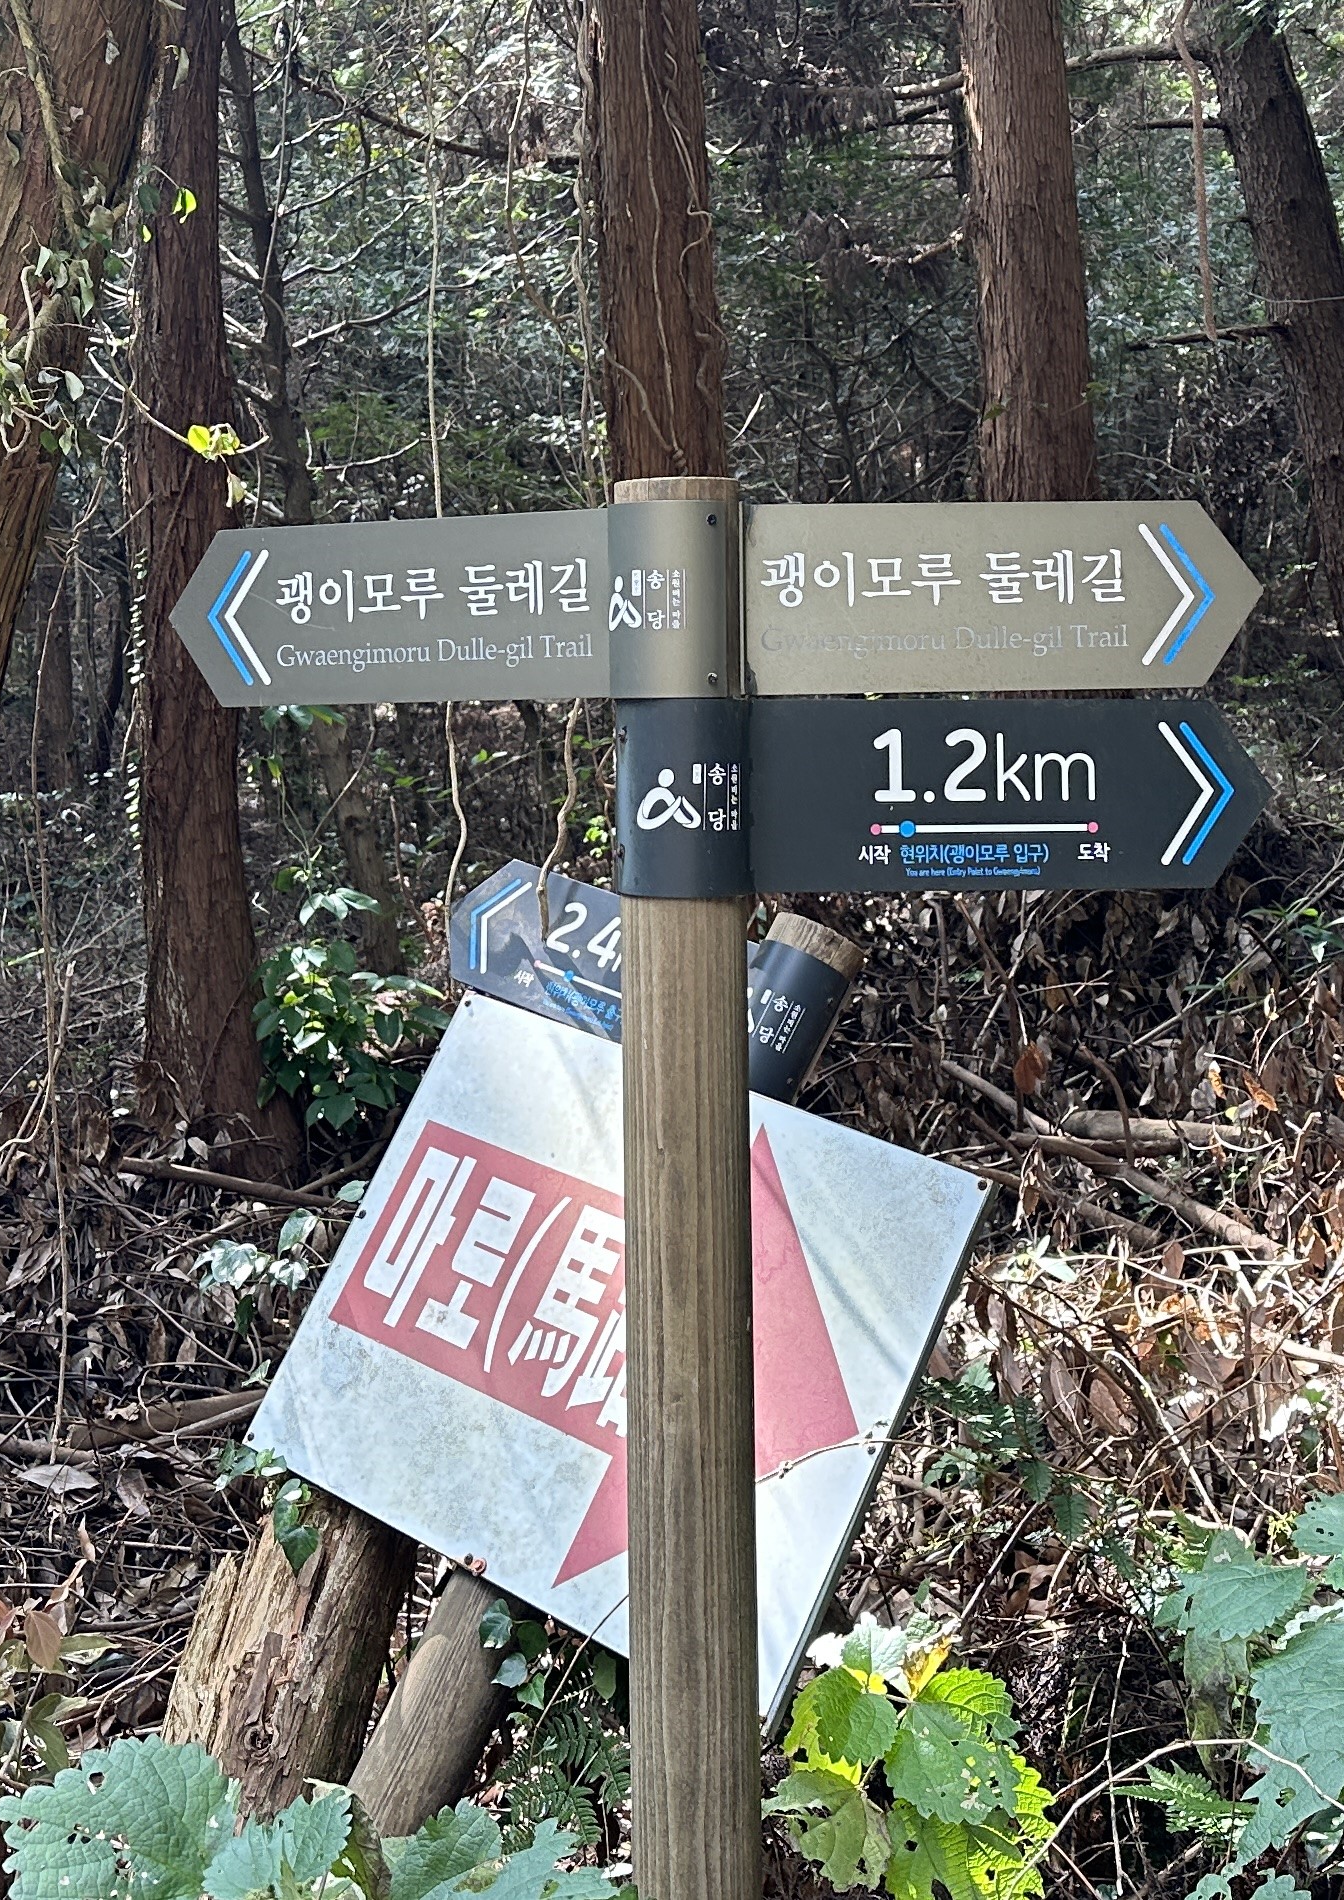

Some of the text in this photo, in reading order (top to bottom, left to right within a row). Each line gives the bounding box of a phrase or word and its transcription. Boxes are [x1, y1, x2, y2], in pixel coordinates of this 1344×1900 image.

[275, 557, 591, 625] 괭이모루 둘레길
[646, 569, 666, 630] 송당
[760, 548, 1127, 608] 괭이모루 둘레길
[276, 633, 594, 673] Gwaengimoru Dulle-gil Trail
[761, 624, 1130, 659] Gwaengimoru Dulle-gil Trail
[873, 728, 1096, 802] 1.2km
[708, 763, 727, 831] 송당
[858, 842, 1111, 865] 시작 현위치(괭이모루 입구) 도착
[931, 867, 945, 877] here
[546, 902, 621, 972] 2.4
